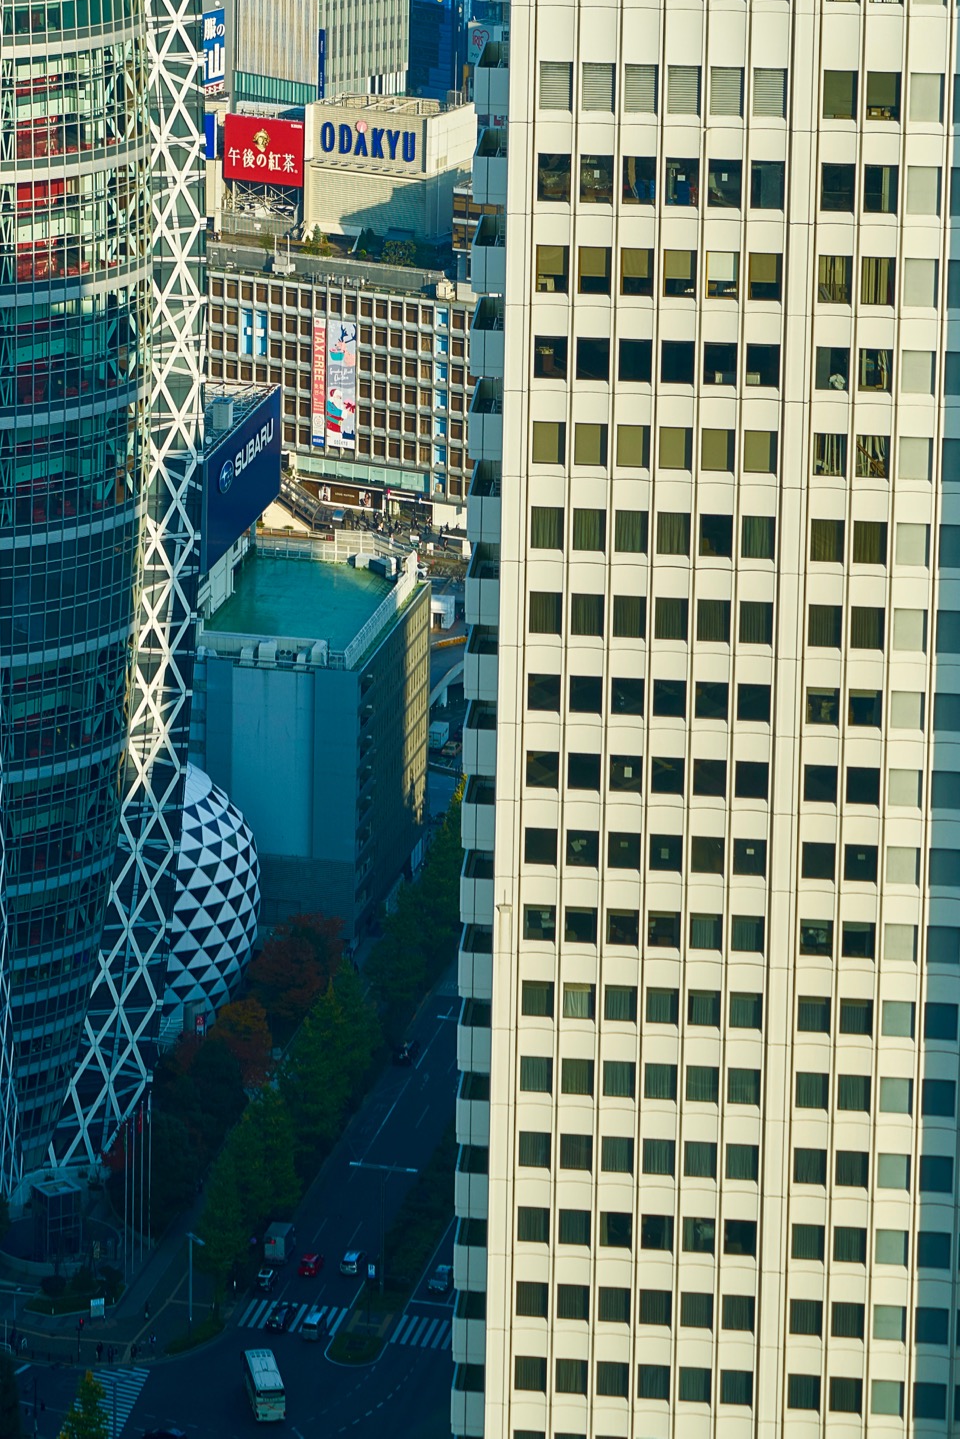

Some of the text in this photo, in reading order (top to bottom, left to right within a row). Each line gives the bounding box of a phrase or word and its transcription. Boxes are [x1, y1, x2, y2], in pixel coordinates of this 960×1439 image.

[320, 120, 416, 163] ODAKYU
[227, 146, 296, 174] 午後の紅茶
[314, 330, 325, 352] TAX
[313, 353, 325, 381] FREE
[234, 417, 274, 477] SUBARU
